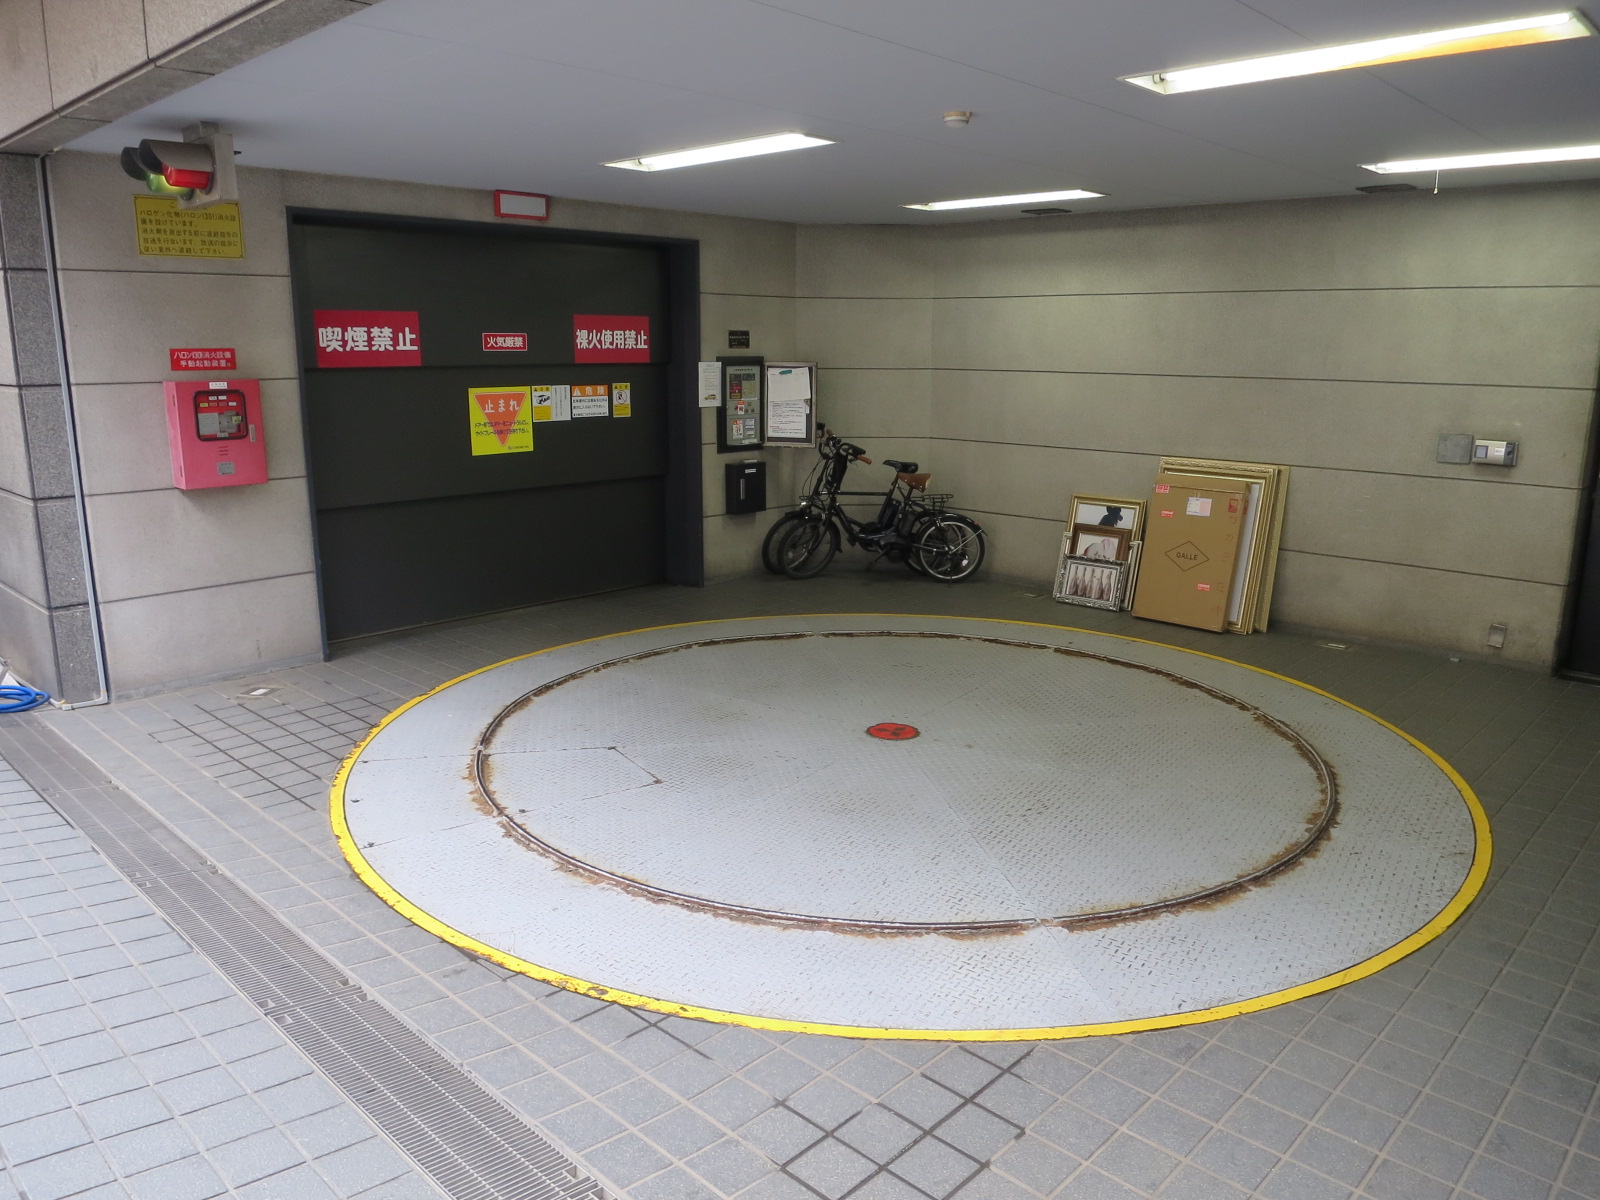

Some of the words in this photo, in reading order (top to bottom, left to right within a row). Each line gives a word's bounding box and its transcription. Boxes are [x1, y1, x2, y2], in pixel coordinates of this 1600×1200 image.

[318, 326, 418, 353] 喫煙禁止
[487, 335, 524, 348] 火気厳禁
[576, 329, 648, 350] 裸火使用禁止
[585, 386, 605, 396] 危険
[484, 398, 520, 413] 止まれ
[1176, 551, 1199, 561] GALLE
